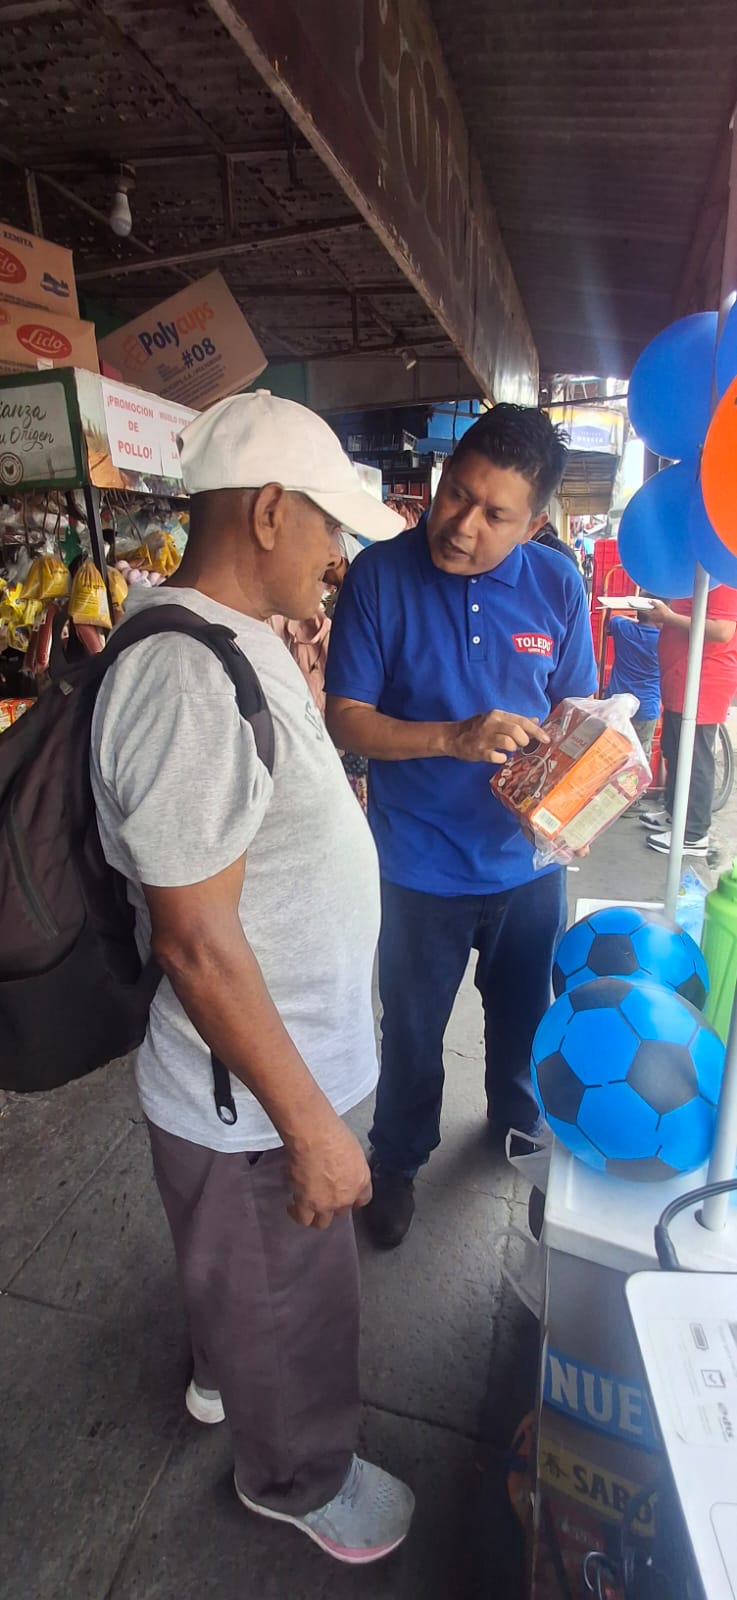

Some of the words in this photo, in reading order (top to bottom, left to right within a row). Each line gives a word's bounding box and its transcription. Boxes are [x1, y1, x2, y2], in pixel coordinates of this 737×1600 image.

[21, 328, 65, 354] Lido
[138, 302, 214, 357] Polycups
[182, 337, 216, 369] #08
[10, 426, 55, 452] Origen
[128, 421, 140, 433] DE
[118, 441, 153, 460] POLLO!
[515, 636, 551, 652] TOLEDO
